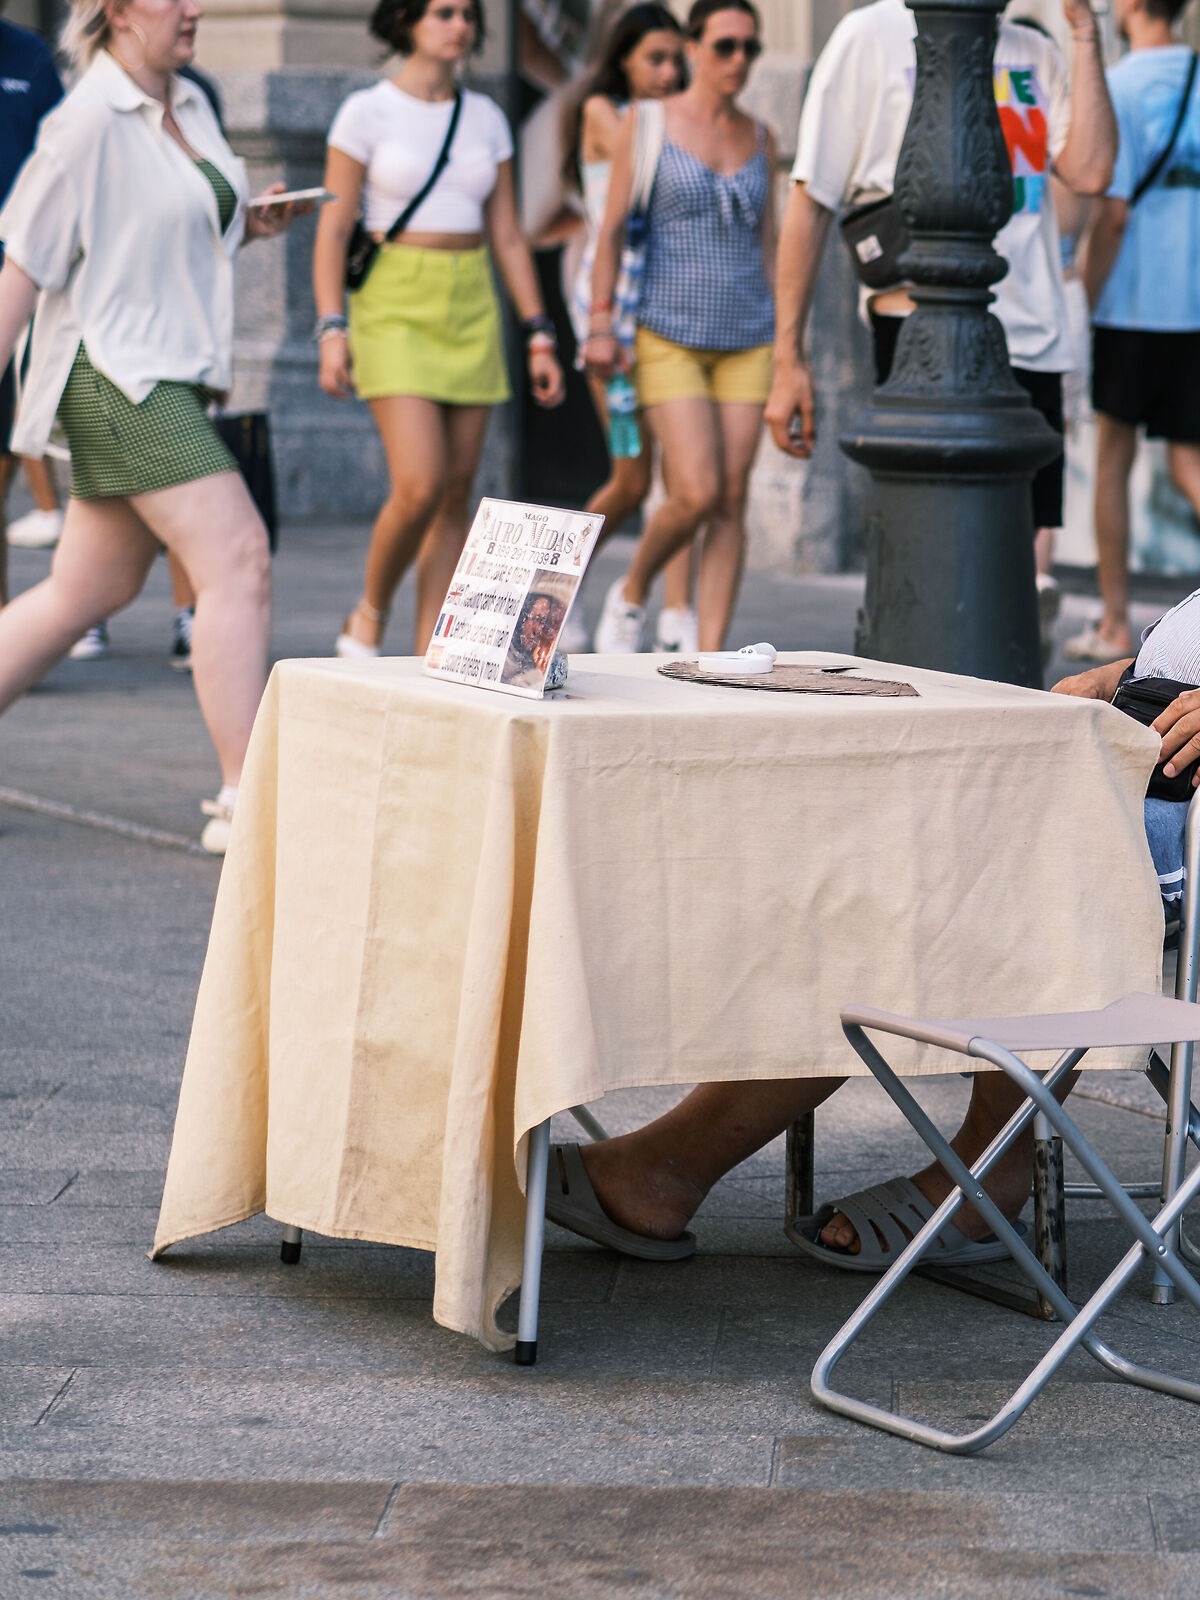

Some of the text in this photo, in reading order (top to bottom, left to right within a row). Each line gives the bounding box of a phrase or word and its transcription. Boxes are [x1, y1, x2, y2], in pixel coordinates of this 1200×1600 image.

[524, 513, 549, 522] MAGO
[525, 521, 576, 554] MIDAS
[510, 547, 526, 561] 291
[528, 550, 549, 565] 7039
